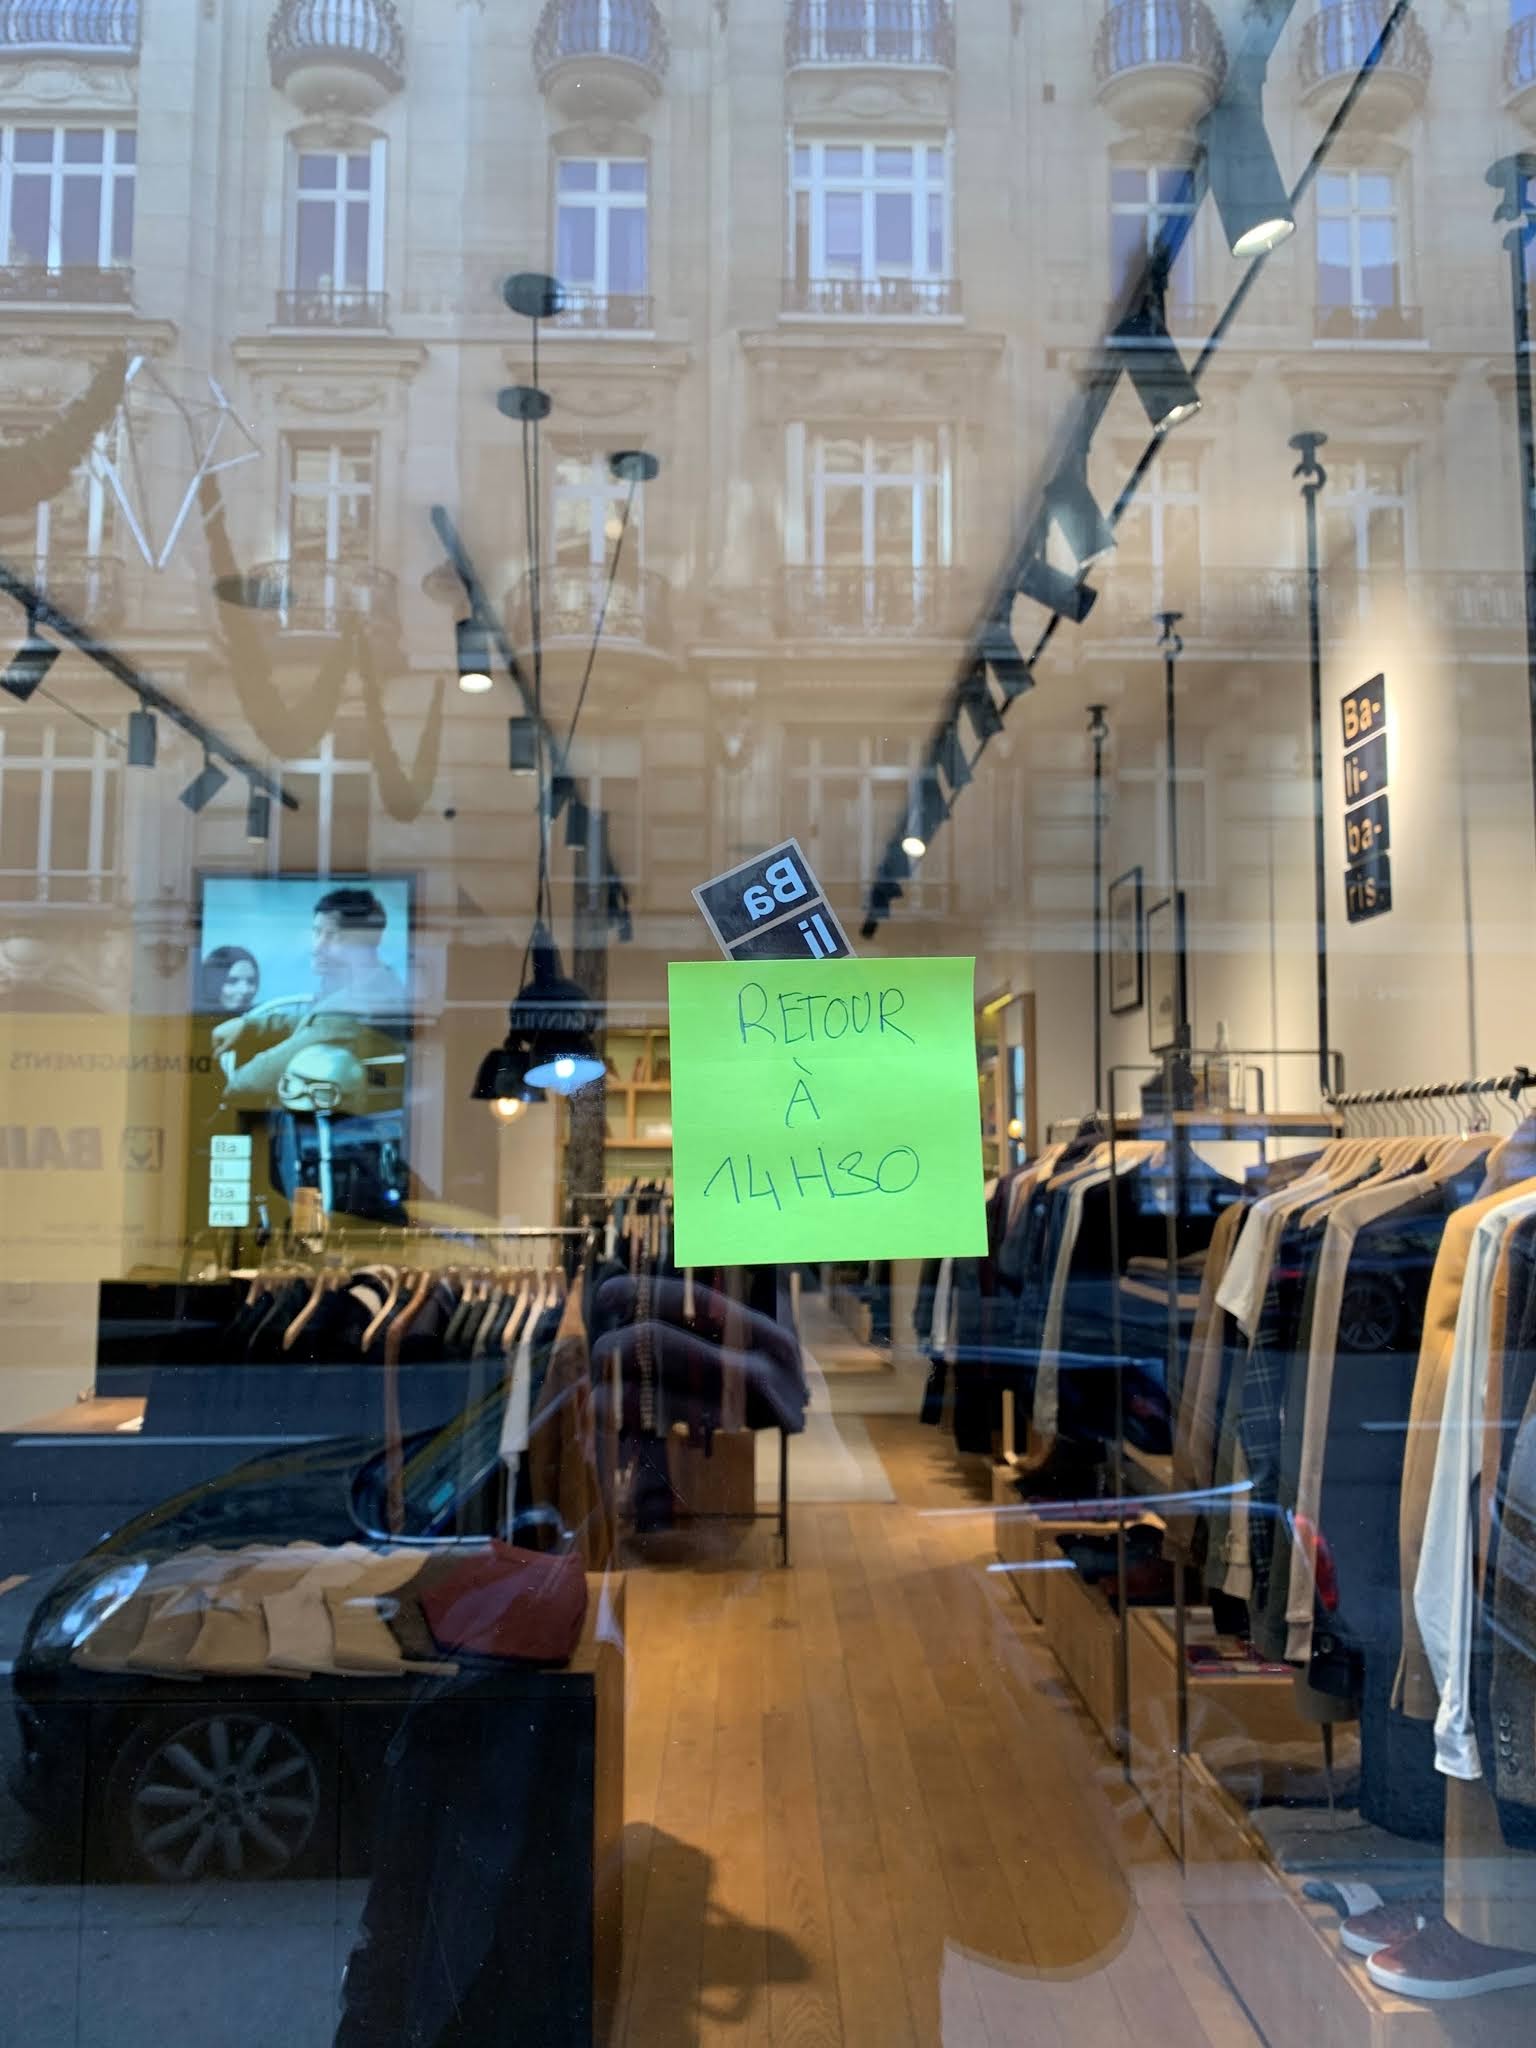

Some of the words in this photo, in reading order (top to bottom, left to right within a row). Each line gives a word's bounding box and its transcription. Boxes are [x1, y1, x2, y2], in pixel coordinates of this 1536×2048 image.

[1343, 697, 1381, 740] Ba-
[1345, 756, 1369, 799] li-
[1347, 816, 1382, 855] ba-
[737, 982, 916, 1045] RETOUR
[784, 1056, 820, 1129] À
[703, 1144, 919, 1211] 14H30
